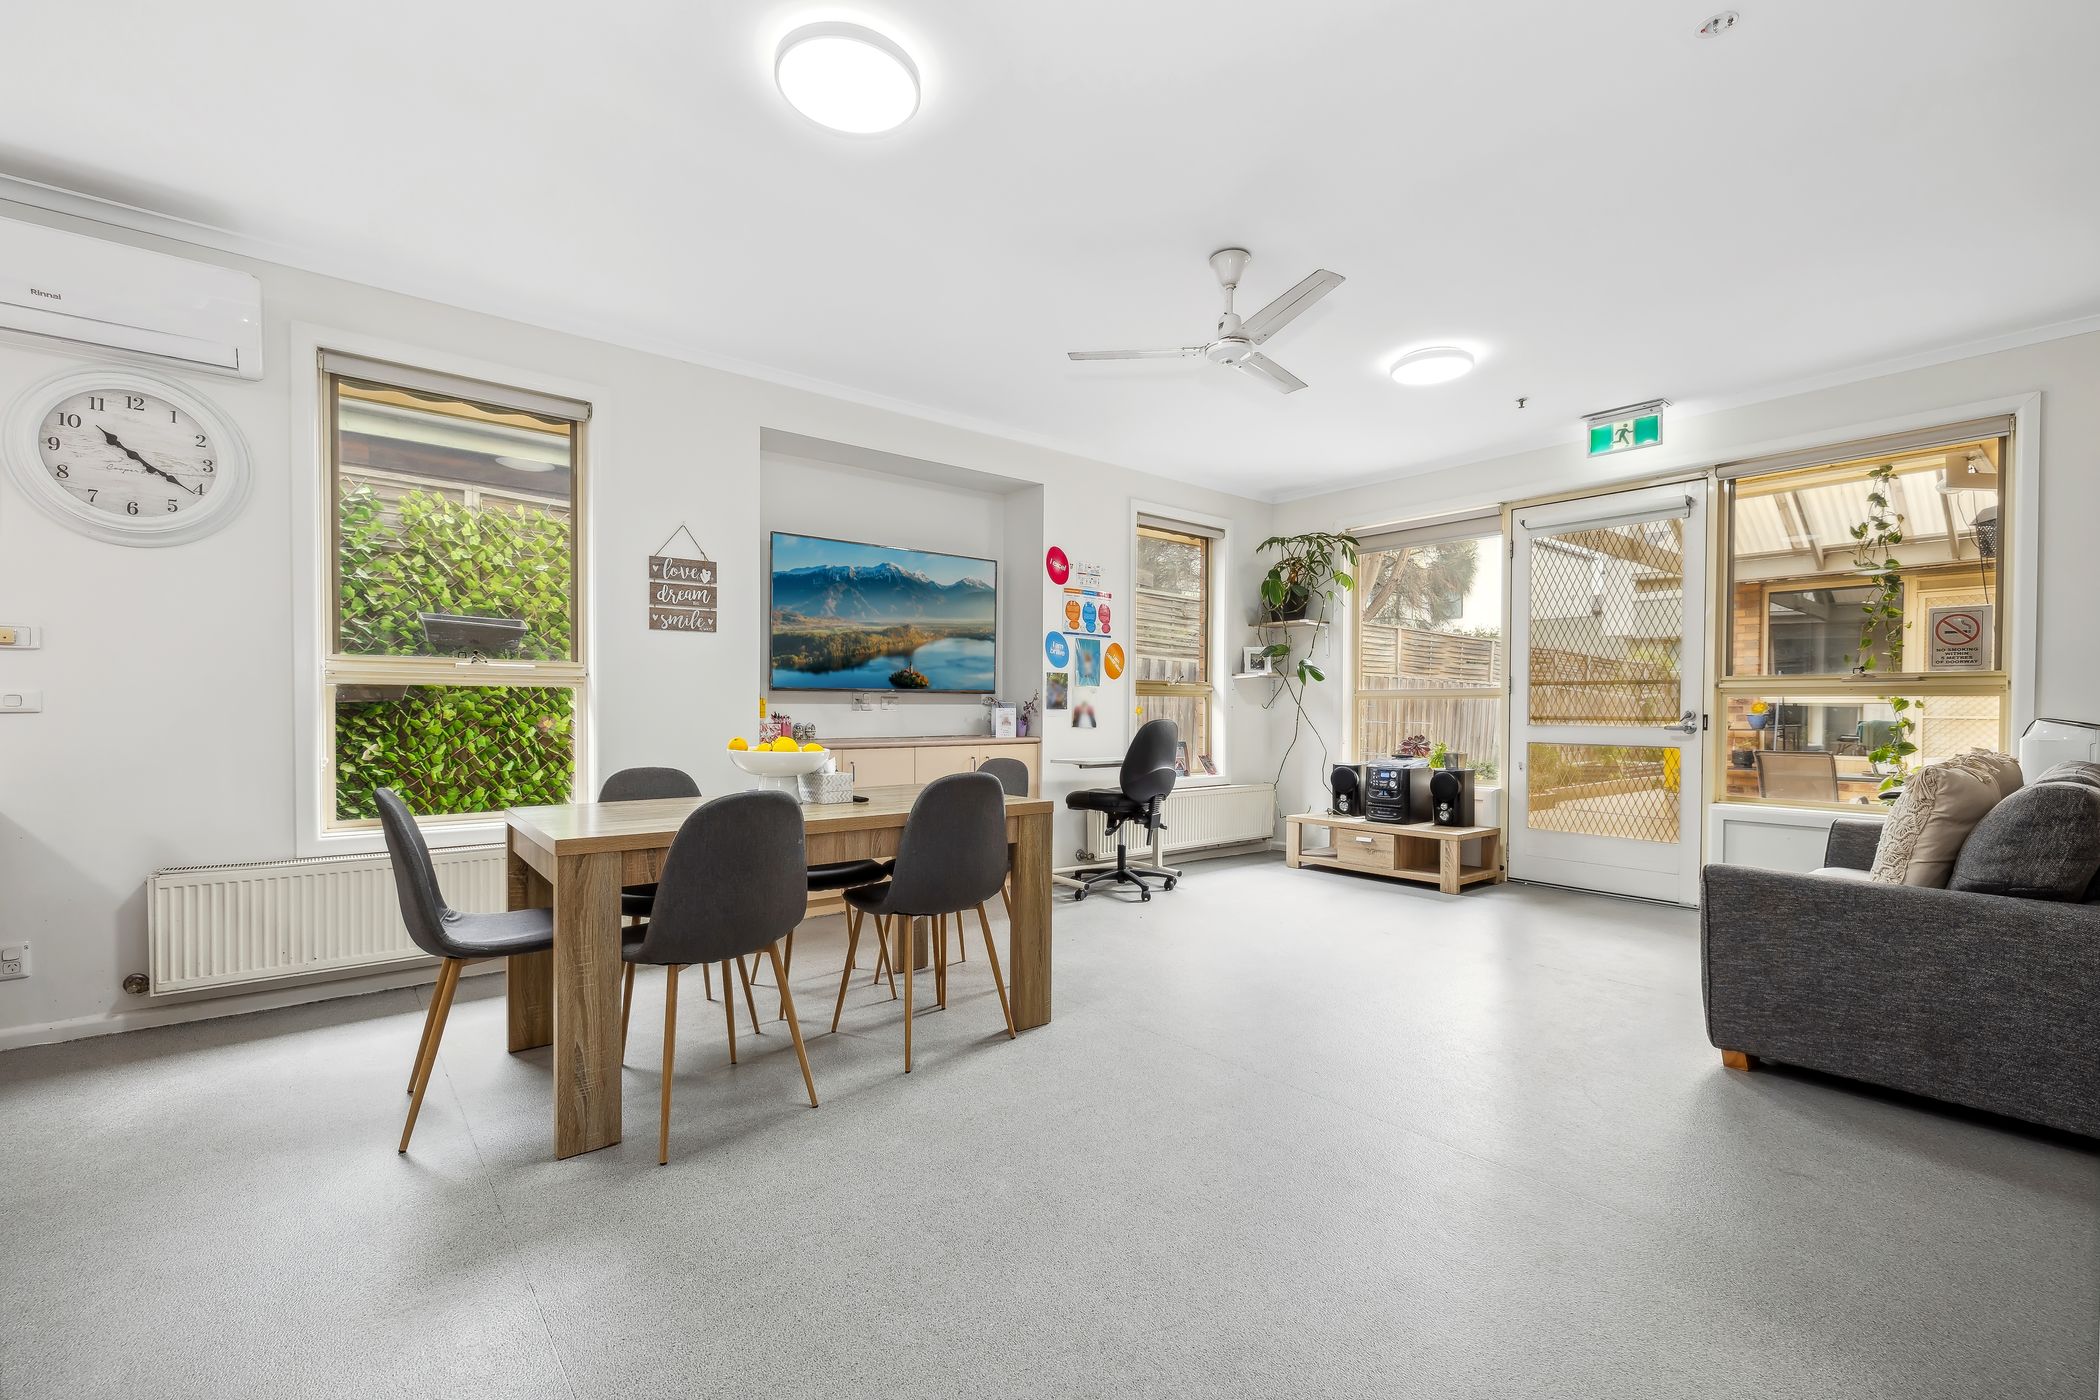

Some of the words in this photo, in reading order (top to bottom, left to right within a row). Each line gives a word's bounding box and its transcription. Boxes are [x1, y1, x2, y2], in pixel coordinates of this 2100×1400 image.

[88, 396, 105, 412] 11
[125, 395, 145, 412] 12
[57, 412, 82, 429] 10
[169, 410, 178, 424] 1
[47, 436, 61, 451] 9
[195, 434, 207, 448] 2
[56, 464, 69, 479] 8
[202, 459, 214, 473] 3
[87, 488, 99, 503] 7
[192, 482, 208, 496] 4
[126, 501, 139, 516] 6
[167, 498, 179, 513] 5
[663, 558, 699, 579] love
[657, 584, 711, 604] dream
[661, 610, 705, 629] smile
